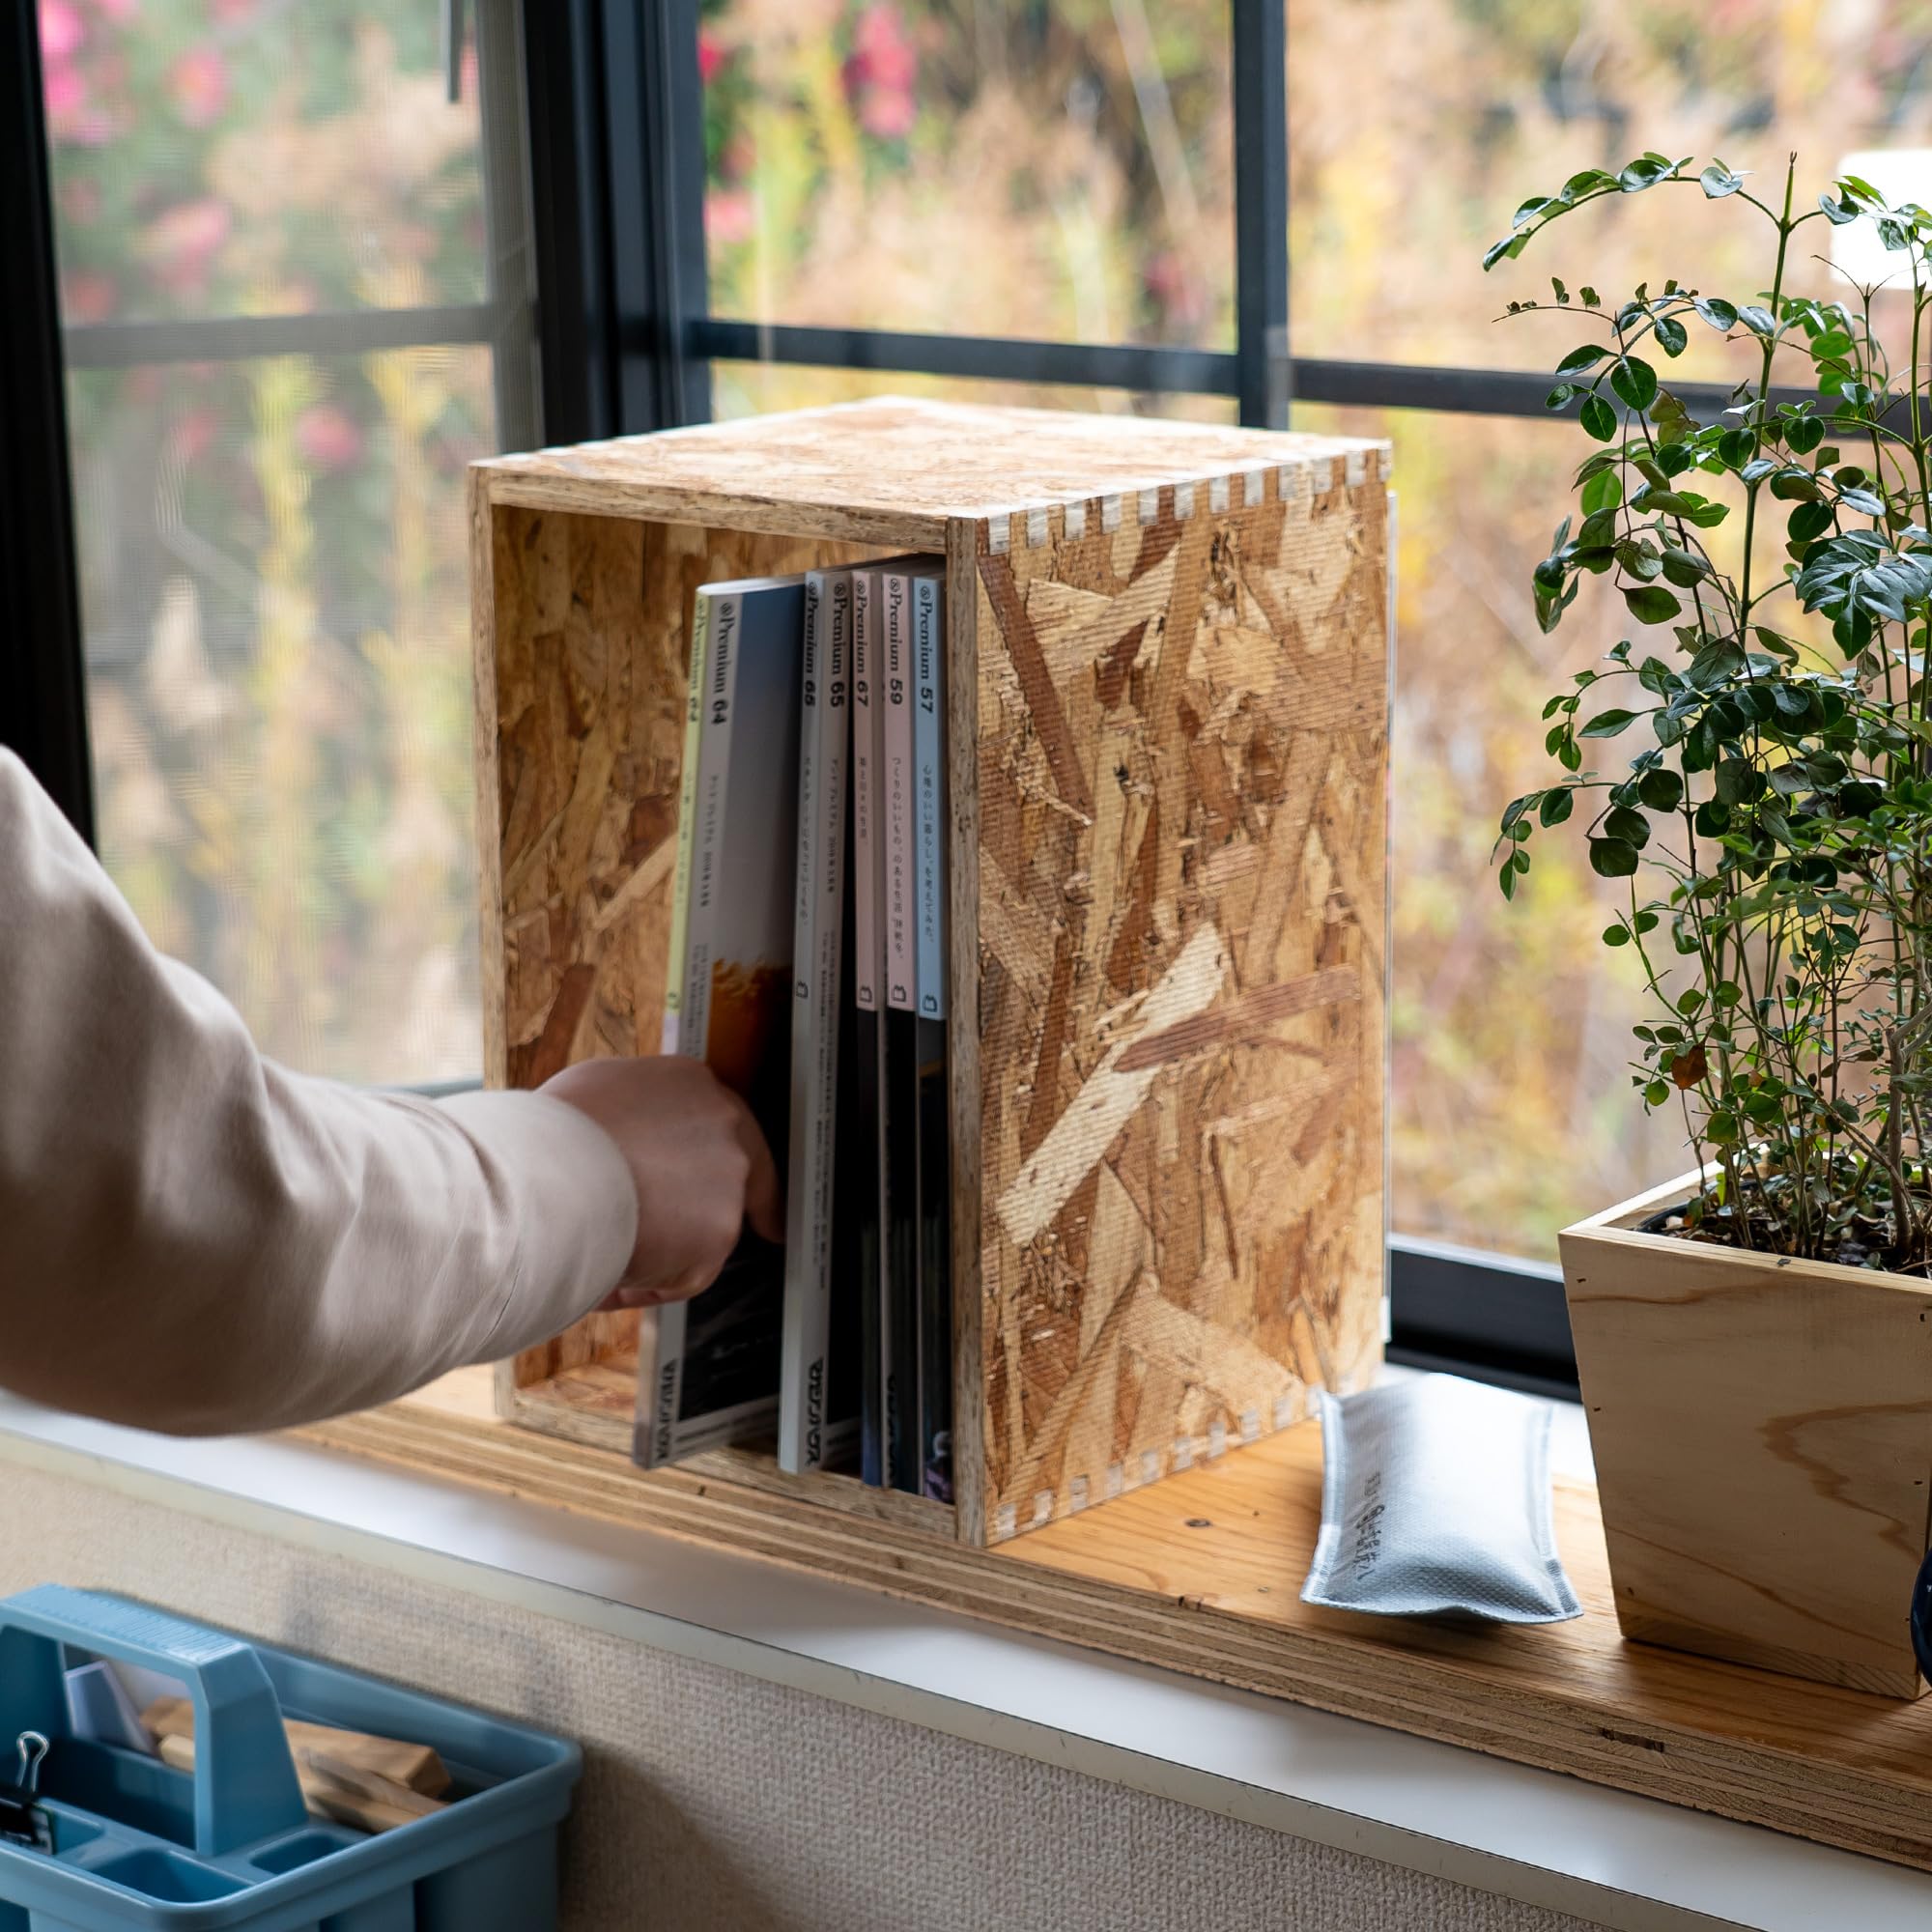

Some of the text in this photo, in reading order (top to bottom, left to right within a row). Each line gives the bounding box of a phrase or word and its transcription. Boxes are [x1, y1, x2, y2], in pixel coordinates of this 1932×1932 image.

[806, 597, 819, 674] Premium
[831, 596, 848, 675] Premium
[856, 595, 868, 674] Premium
[890, 592, 903, 672] Premium
[920, 600, 934, 680] Premium
[711, 698, 729, 724] 64
[830, 680, 845, 708] 65
[856, 679, 869, 707] 67
[890, 677, 903, 705] 59
[920, 686, 934, 714] 57
